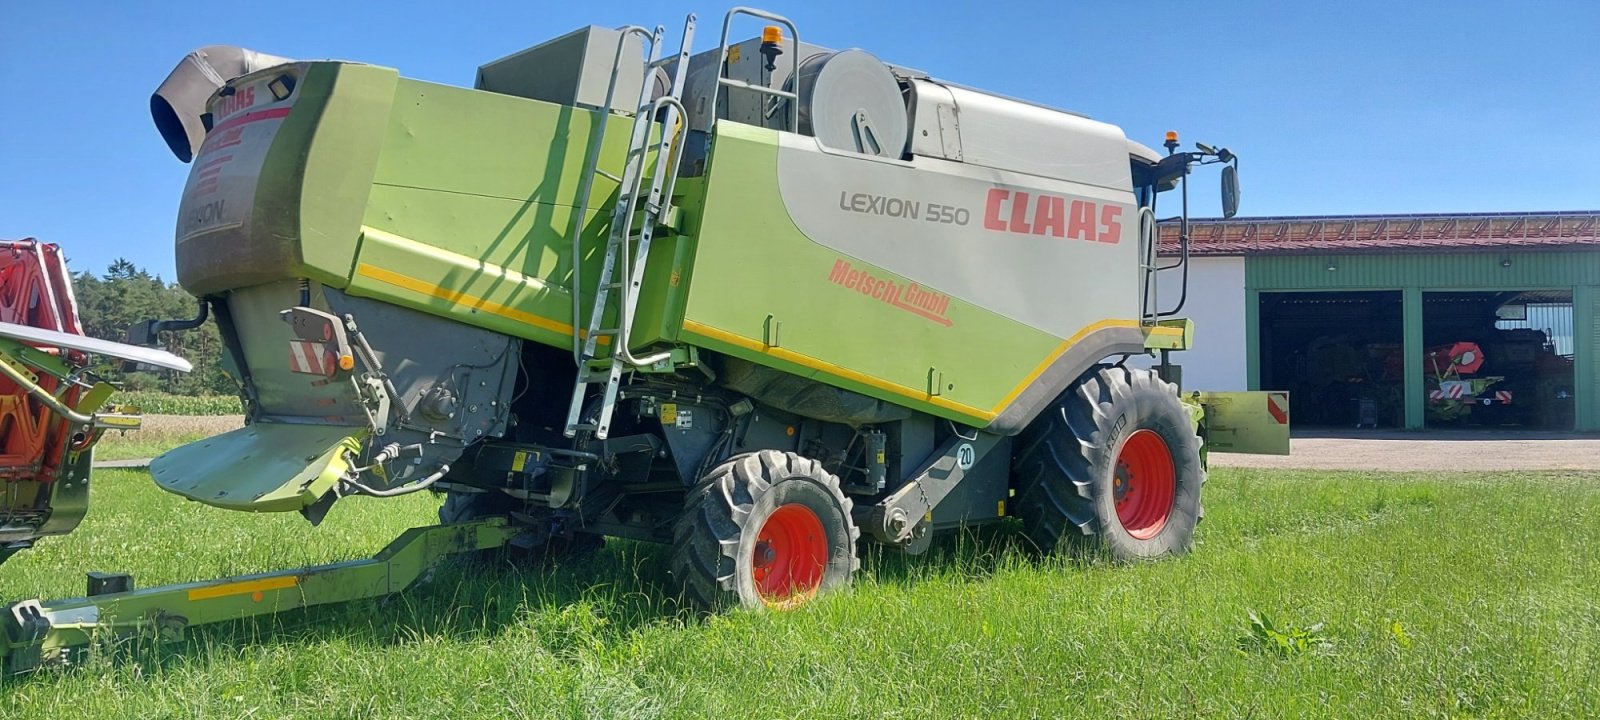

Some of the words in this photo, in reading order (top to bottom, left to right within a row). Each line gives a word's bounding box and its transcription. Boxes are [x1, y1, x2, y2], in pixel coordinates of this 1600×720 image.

[840, 190, 920, 220] LEXION
[926, 203, 970, 226] 550
[983, 187, 1123, 245] CLAAS
[904, 282, 950, 315] GmbH
[961, 448, 971, 465] 20
